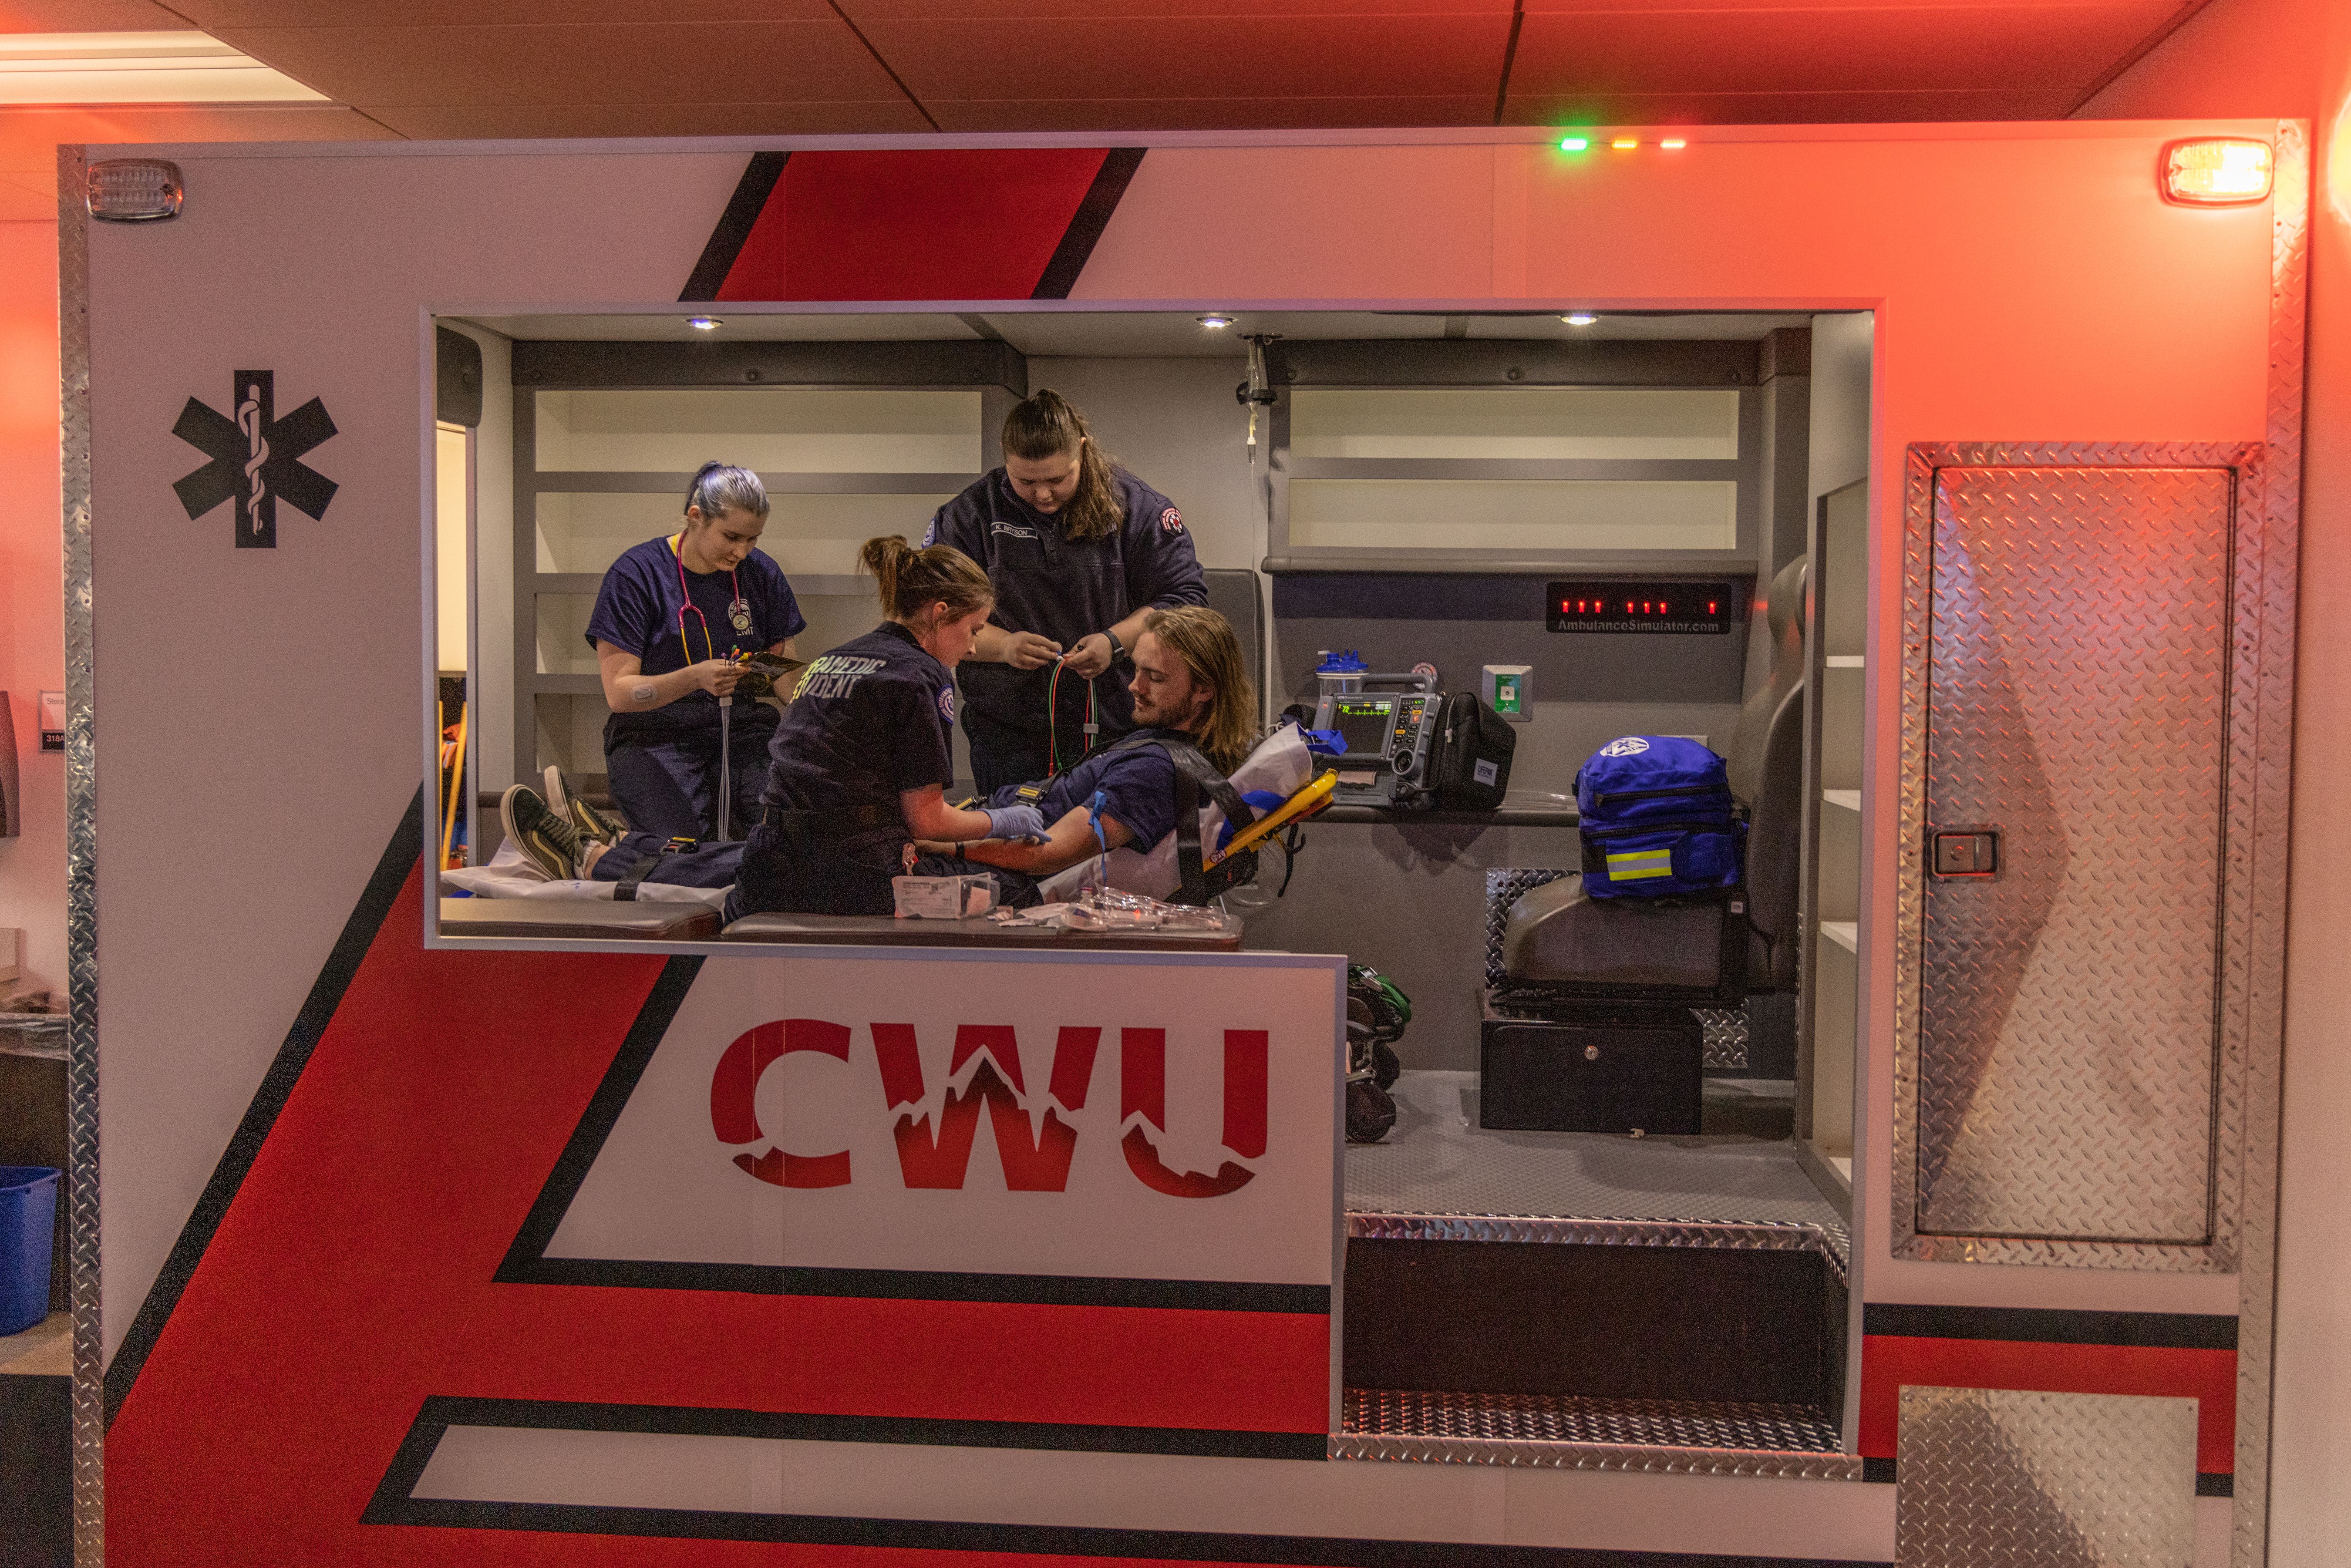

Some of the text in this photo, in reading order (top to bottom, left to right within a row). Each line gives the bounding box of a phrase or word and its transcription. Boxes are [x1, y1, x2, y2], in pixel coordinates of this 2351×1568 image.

[1004, 525, 1027, 535] BRYSON
[1557, 619, 1720, 631] AmbulanceSimulator.com
[710, 1017, 1269, 1198] CWU
